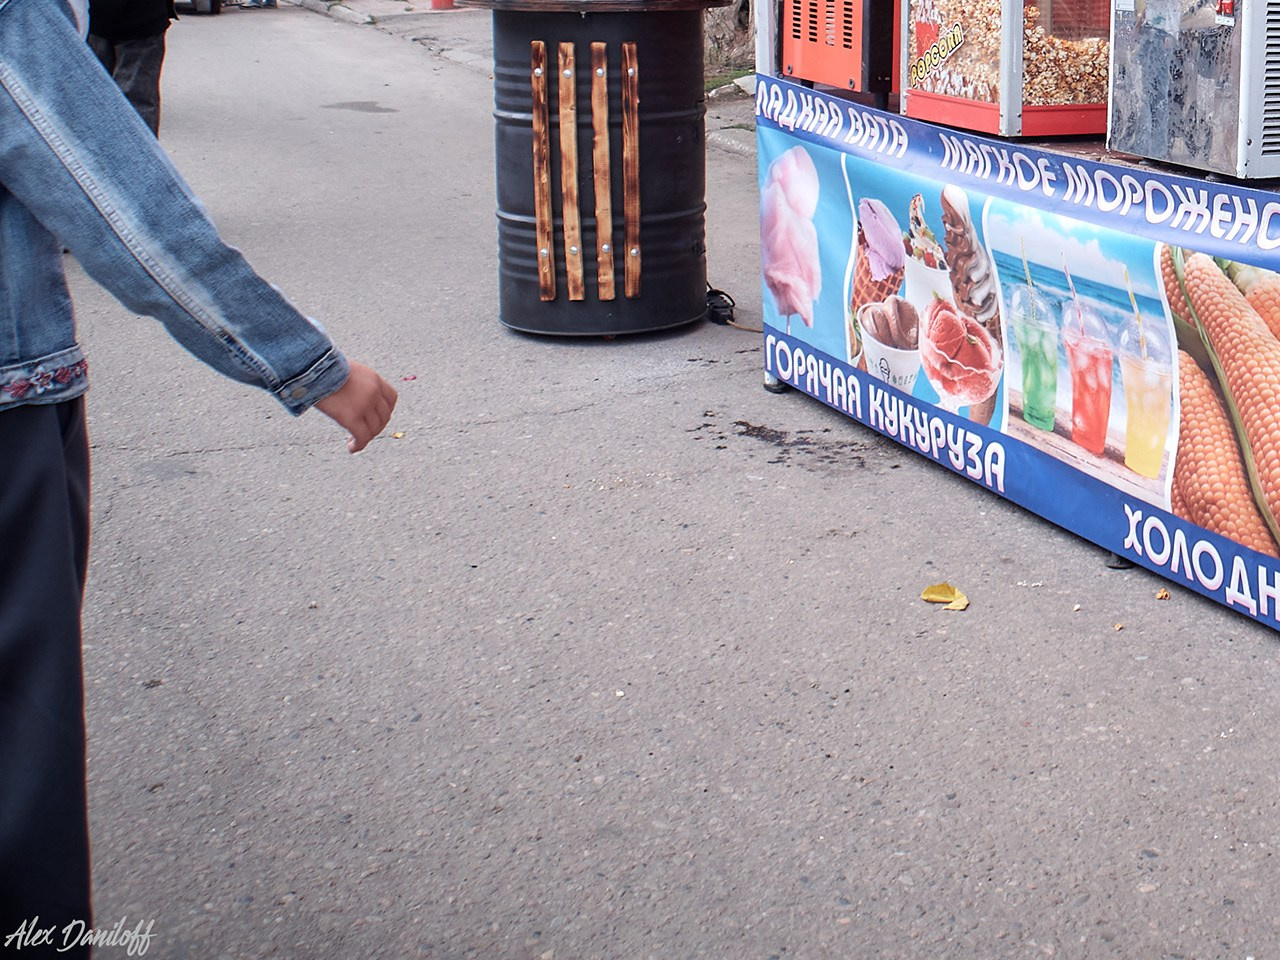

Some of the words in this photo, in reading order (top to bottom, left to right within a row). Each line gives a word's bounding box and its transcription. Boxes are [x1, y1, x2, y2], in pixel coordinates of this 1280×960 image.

[911, 23, 964, 88] POPCORN
[756, 80, 844, 139] ЛАДКАЯ
[848, 107, 909, 158] ВАТА
[939, 132, 1057, 197] МЯГКОЕ
[766, 334, 863, 419] ГОРЯЧАЯ
[869, 384, 1006, 493] КУКУРУЗА
